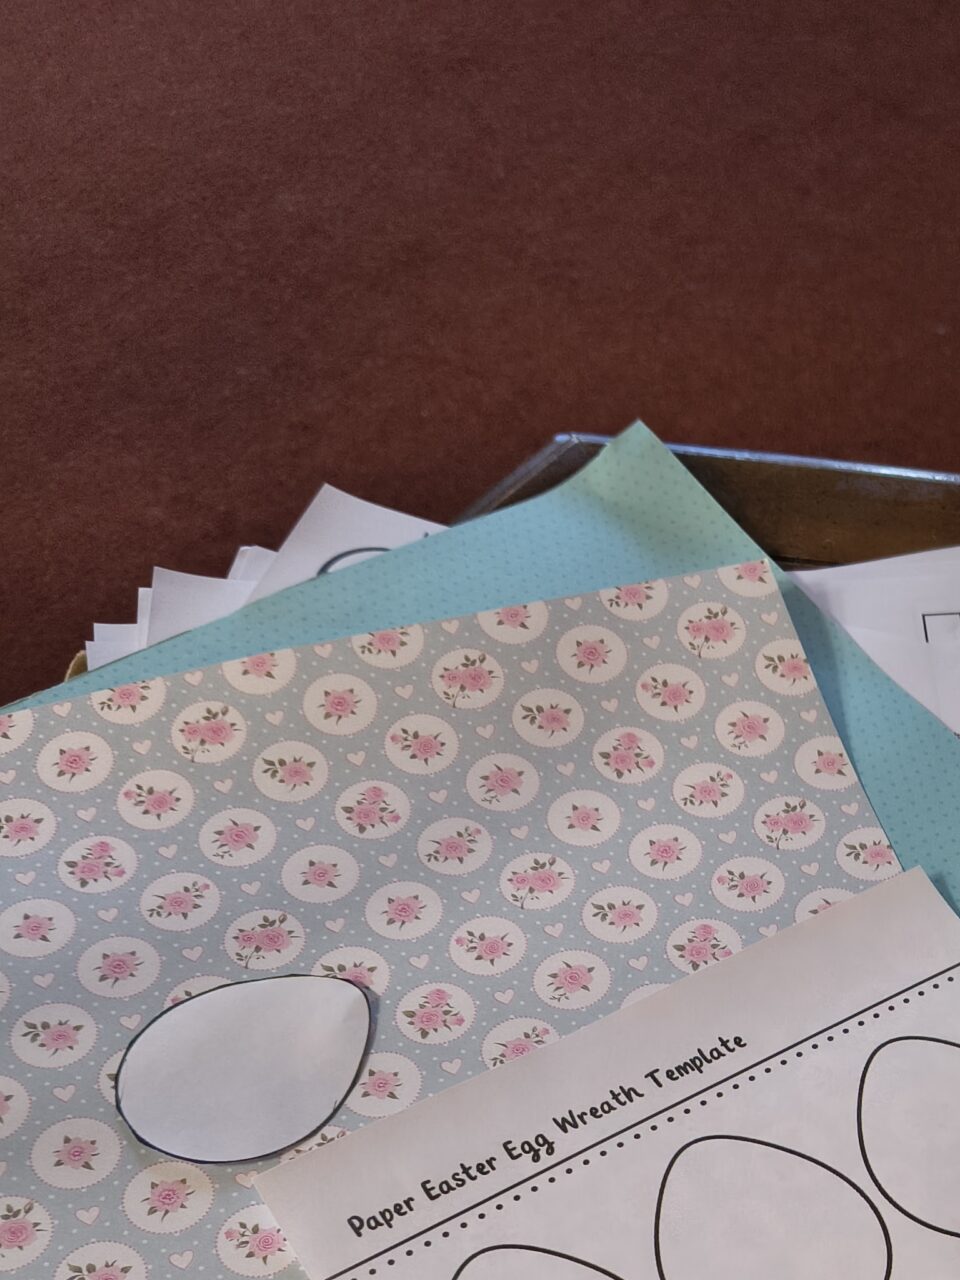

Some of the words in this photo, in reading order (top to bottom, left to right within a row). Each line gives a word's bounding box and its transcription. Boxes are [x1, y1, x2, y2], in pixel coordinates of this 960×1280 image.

[347, 1196, 415, 1237] Paper
[420, 1156, 496, 1201] Easter
[502, 1133, 555, 1163] Egg
[552, 1085, 645, 1134] Wreath
[644, 1035, 747, 1088] Template
